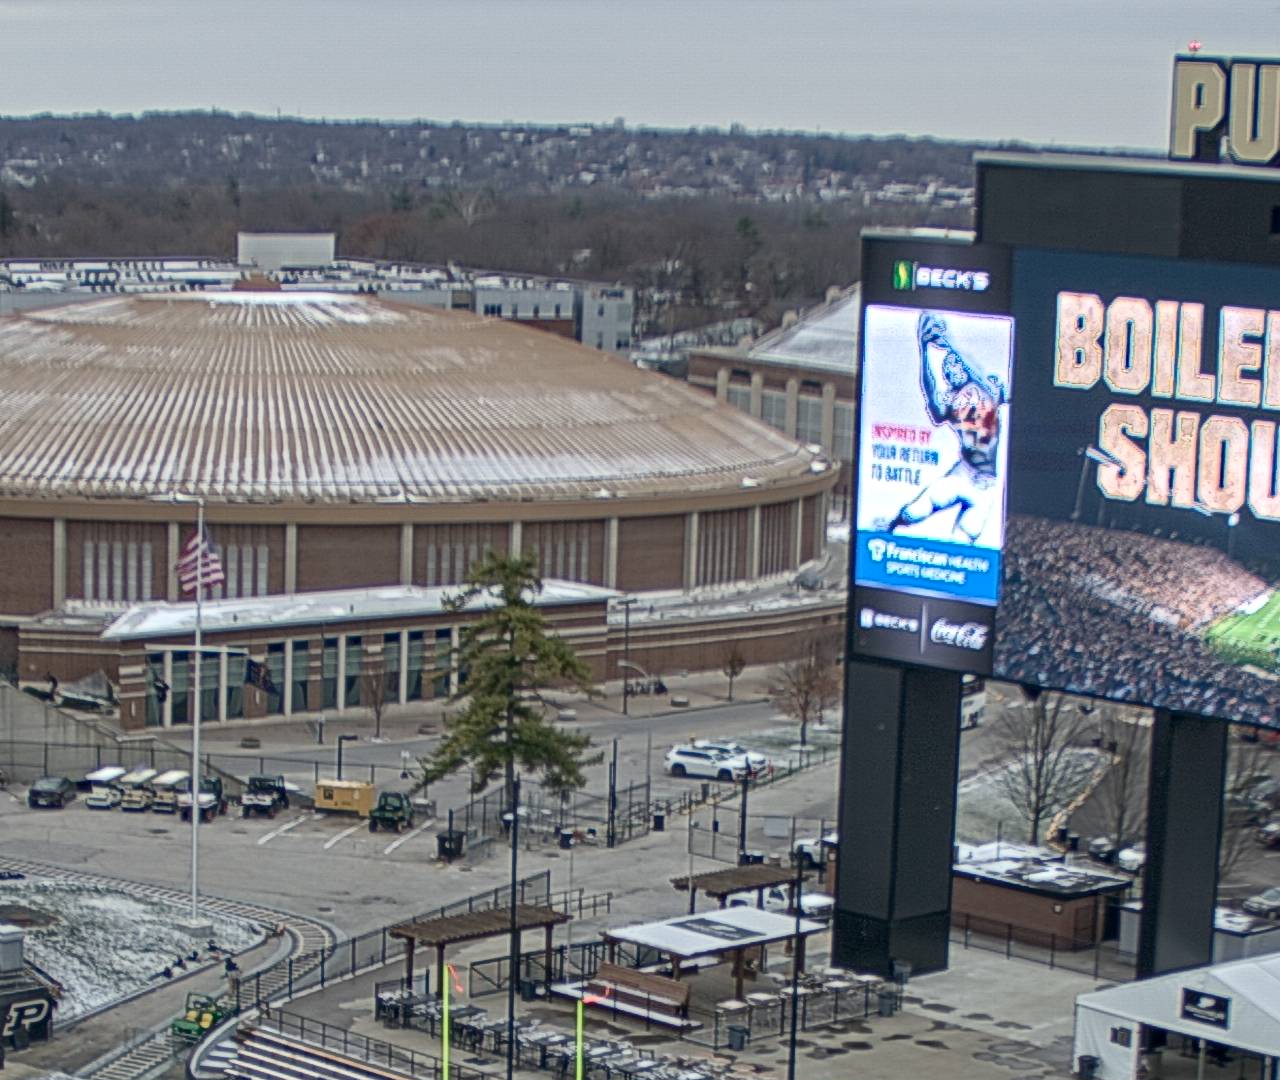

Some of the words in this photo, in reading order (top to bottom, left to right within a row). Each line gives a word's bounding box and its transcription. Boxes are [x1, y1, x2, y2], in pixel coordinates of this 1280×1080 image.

[916, 267, 990, 291] BECK'S
[884, 464, 921, 485] BATTLE
[3, 999, 49, 1036] P
